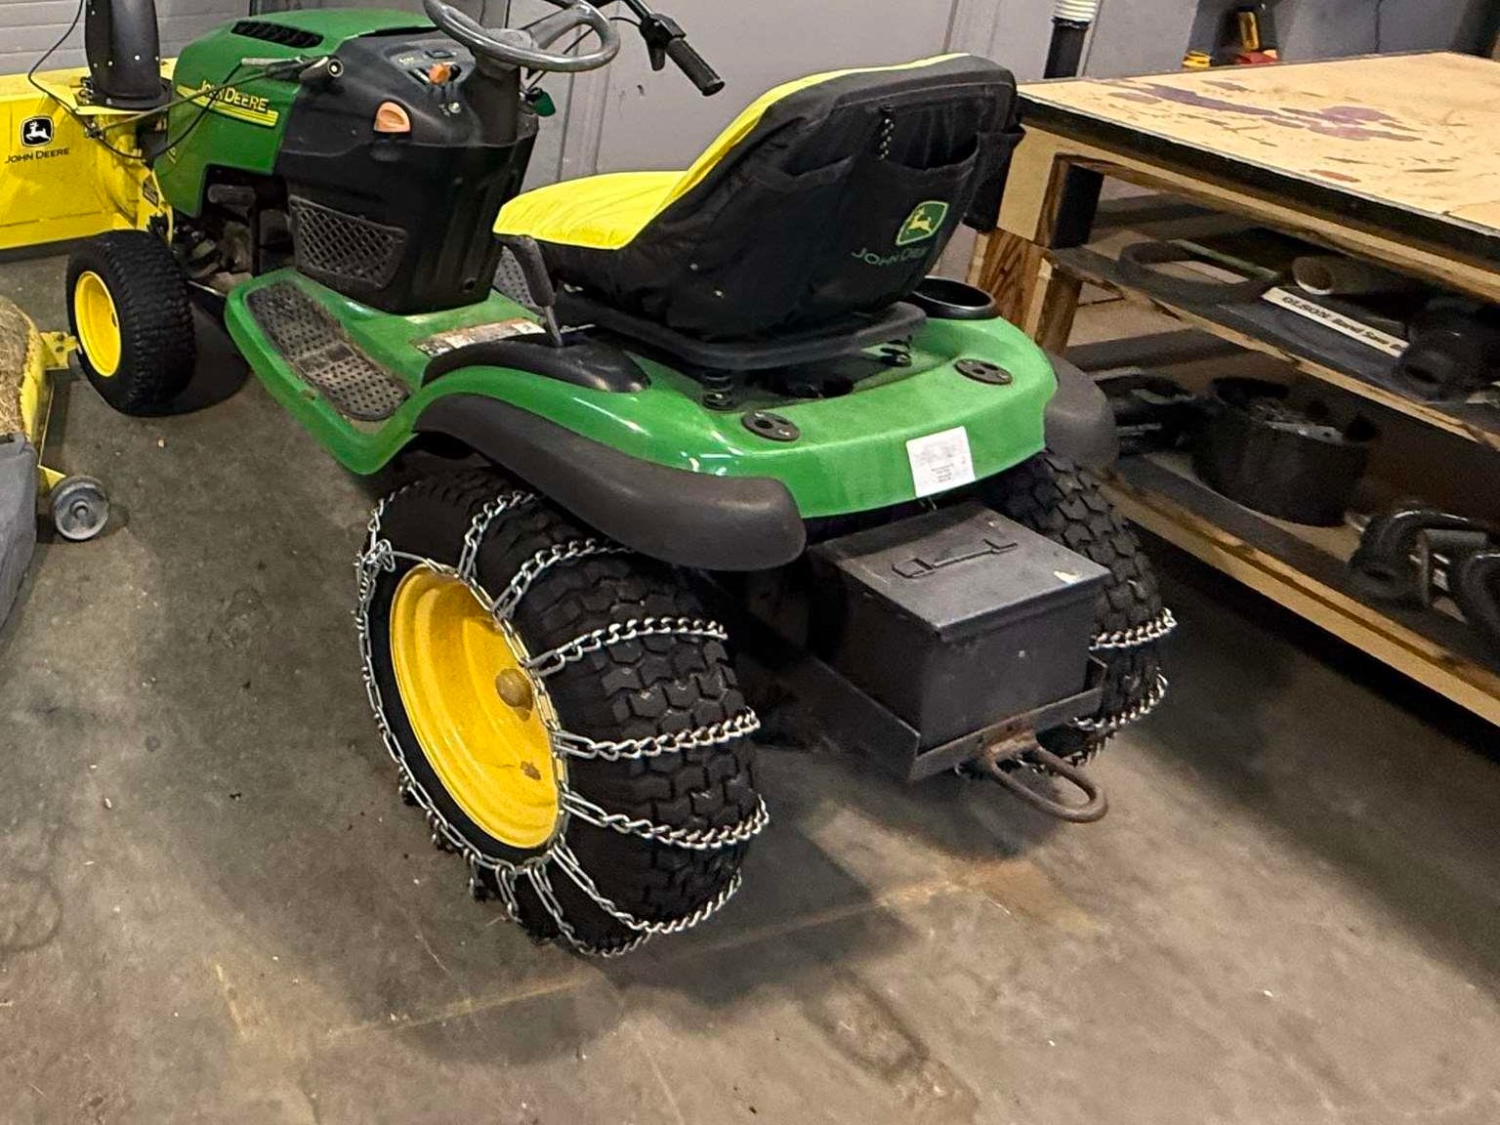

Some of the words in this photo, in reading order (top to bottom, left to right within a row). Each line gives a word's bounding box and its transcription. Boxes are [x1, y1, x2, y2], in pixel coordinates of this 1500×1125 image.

[197, 80, 224, 101] JON
[224, 87, 269, 112] DEERE
[5, 153, 34, 164] JOHN
[35, 147, 70, 159] DEERE
[851, 247, 898, 266] JOHN
[1282, 296, 1331, 319] OLSON
